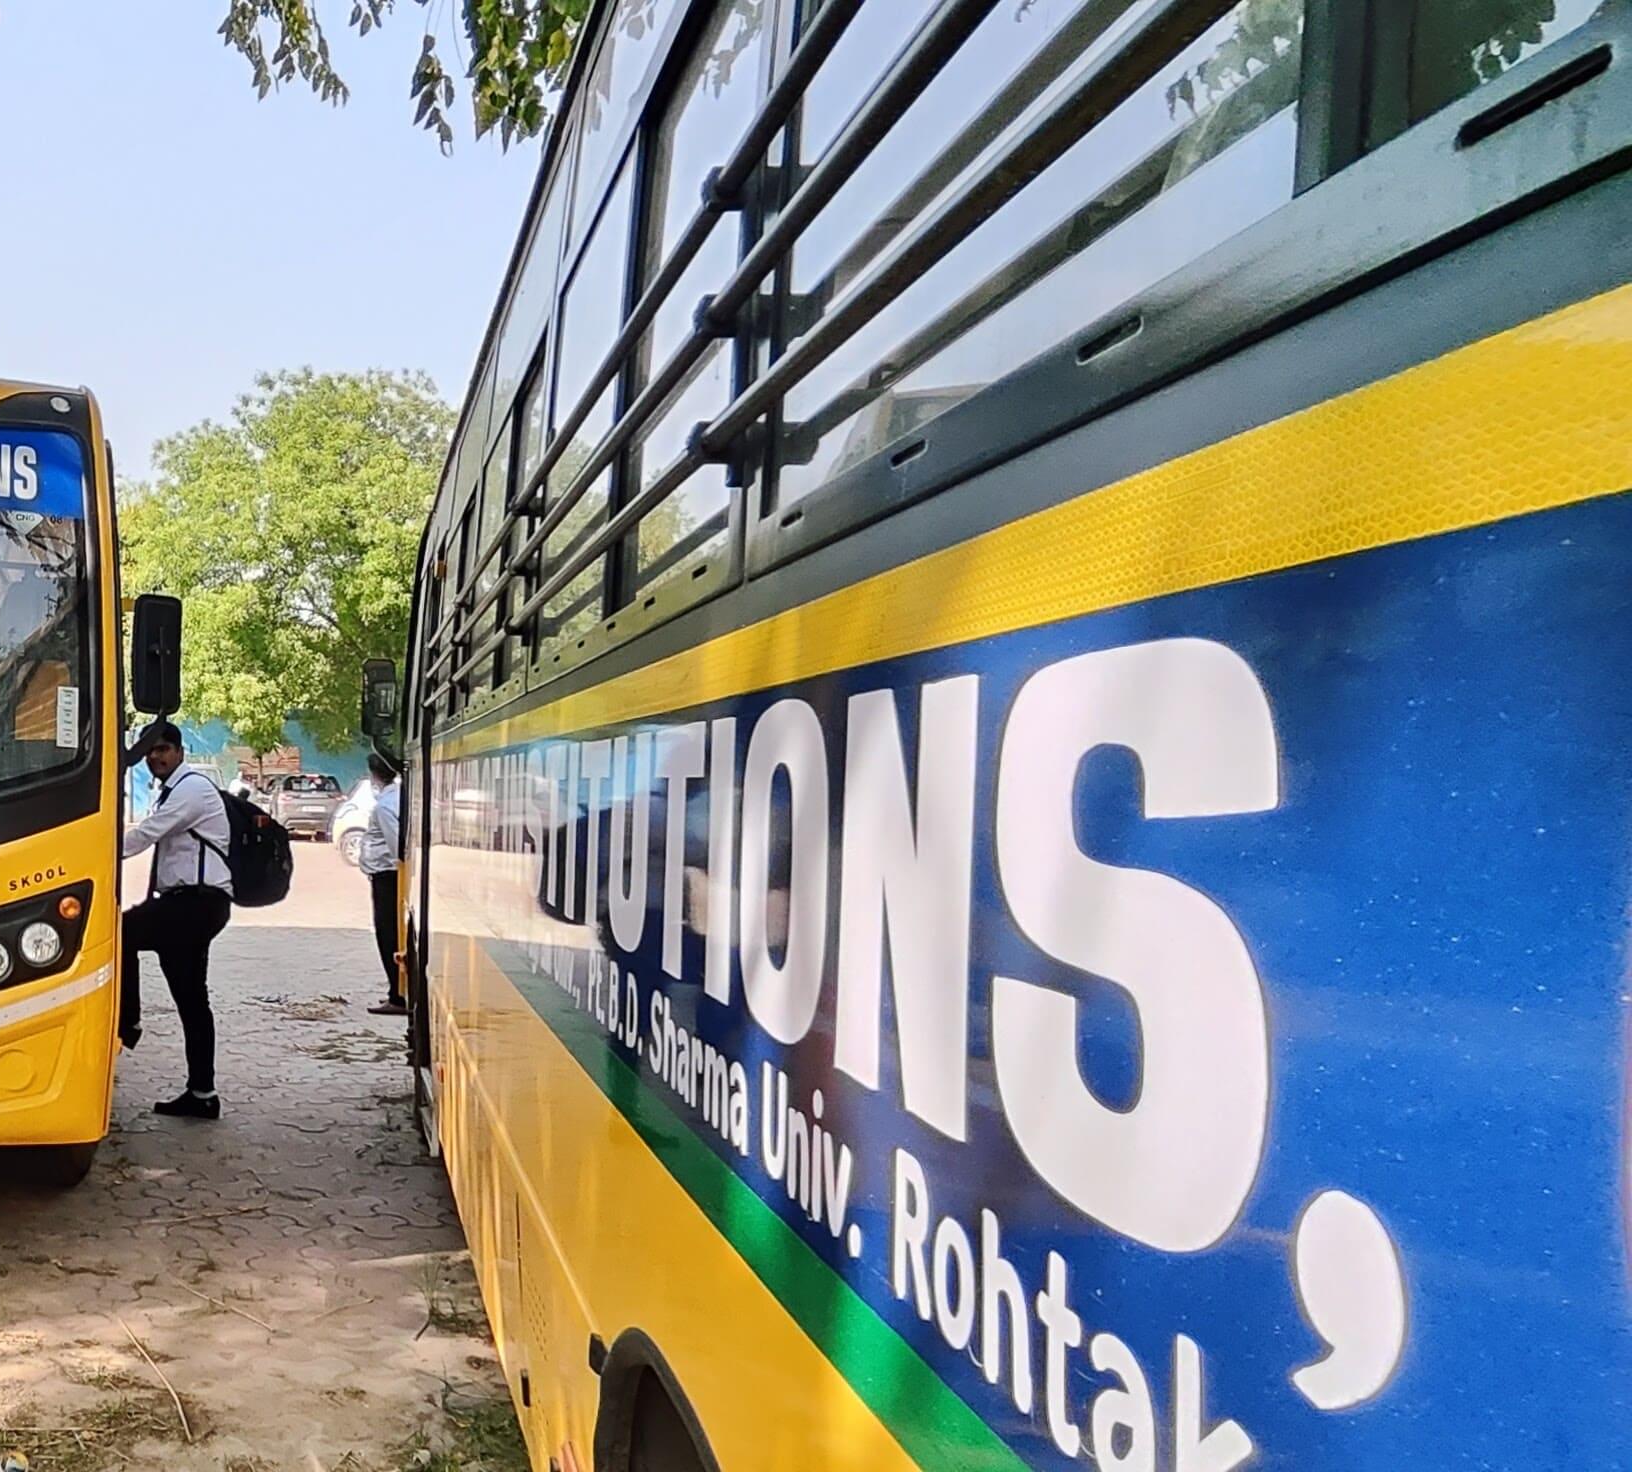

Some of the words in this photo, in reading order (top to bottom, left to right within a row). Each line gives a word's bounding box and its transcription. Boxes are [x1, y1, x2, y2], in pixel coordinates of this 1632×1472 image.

[9, 866, 66, 891] SKOOL
[649, 989, 749, 1157] Sharma
[762, 1060, 862, 1258] Univ.
